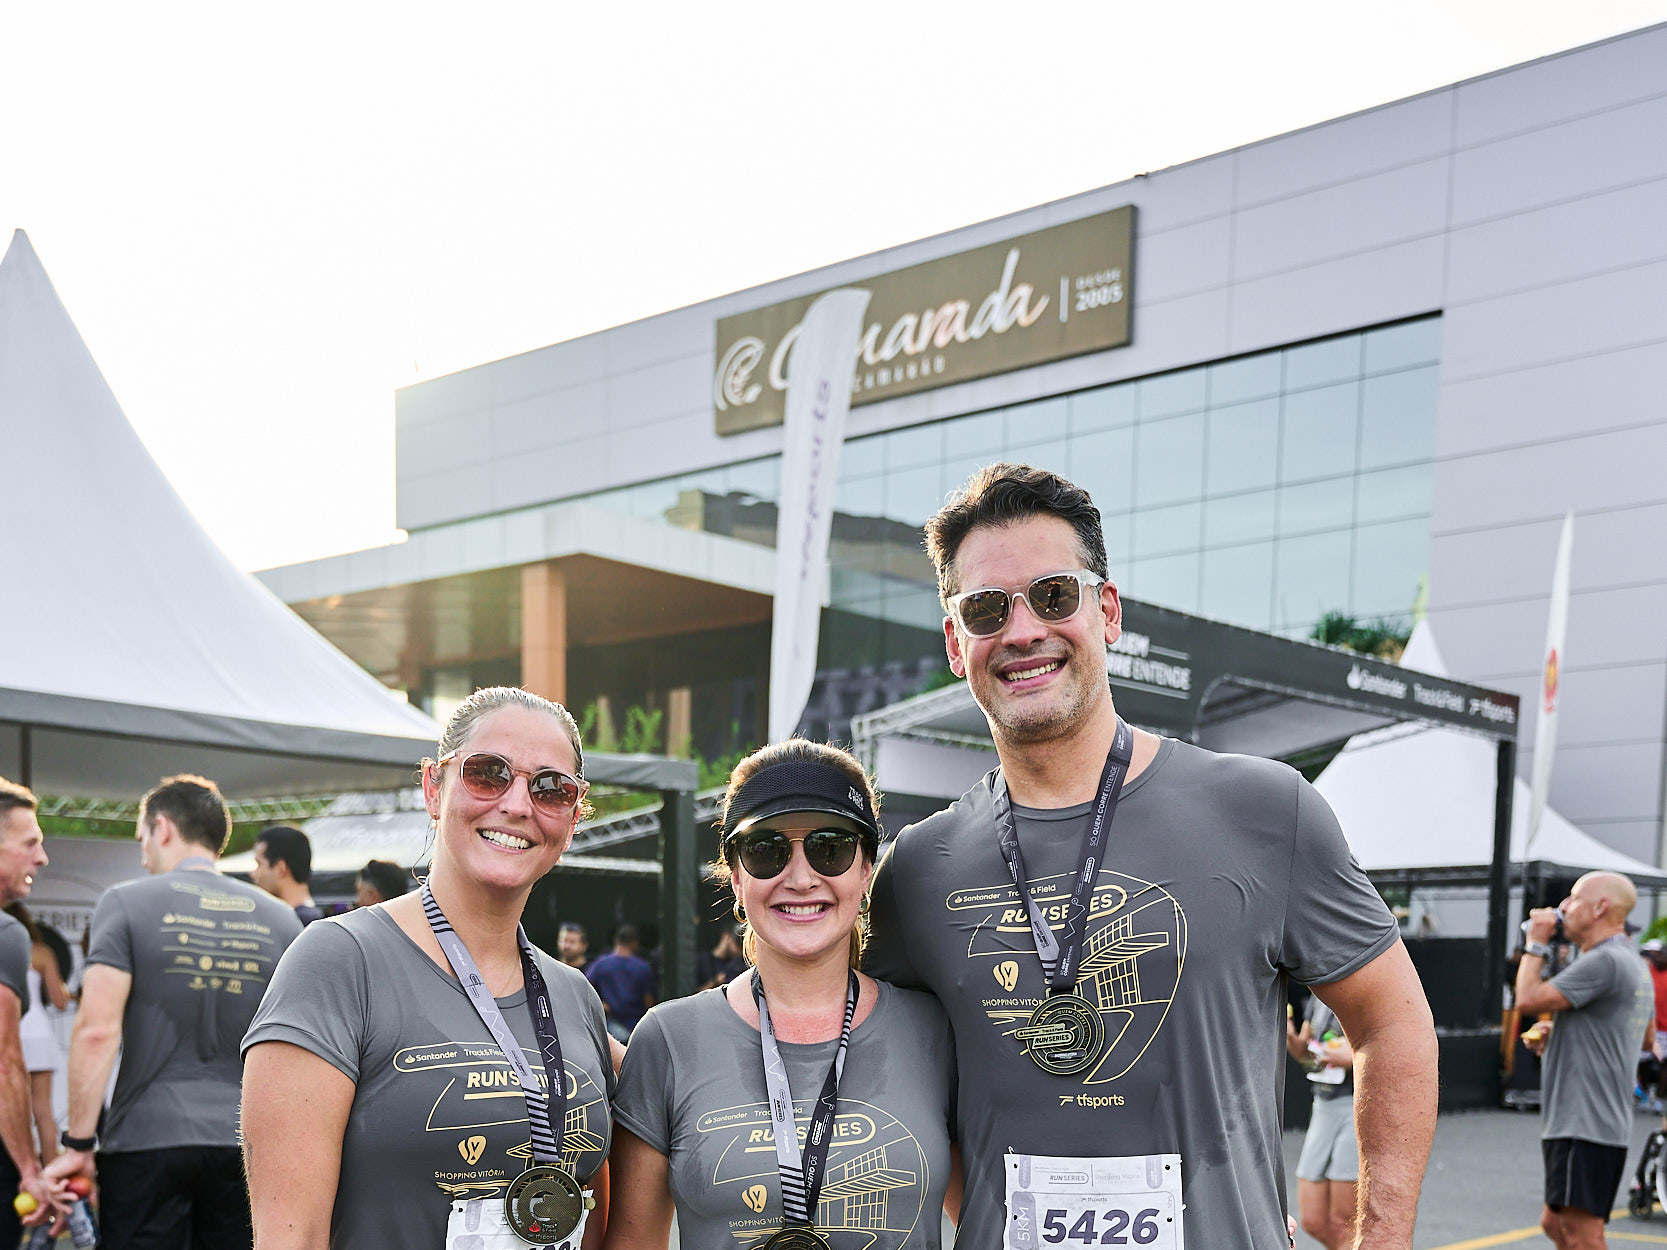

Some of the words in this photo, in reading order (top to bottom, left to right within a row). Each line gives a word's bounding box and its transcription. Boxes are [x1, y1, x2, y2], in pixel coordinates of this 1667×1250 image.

[1075, 283, 1123, 312] 2005
[1092, 813, 1102, 835] QUEM
[1097, 791, 1109, 814] CORRE
[1103, 765, 1118, 793] ENTENDE
[963, 893, 1001, 903] Santander
[981, 998, 1019, 1007] SHOPPING
[415, 1051, 458, 1062] Santander
[1076, 1093, 1125, 1109] tfsports
[712, 1112, 748, 1123] Santander
[434, 1171, 477, 1180] SHOPPING
[807, 1166, 816, 1189] QUEM
[729, 1218, 767, 1228] SHOPPING
[1017, 1206, 1031, 1242] 5KM
[1041, 1208, 1160, 1245] 5426
